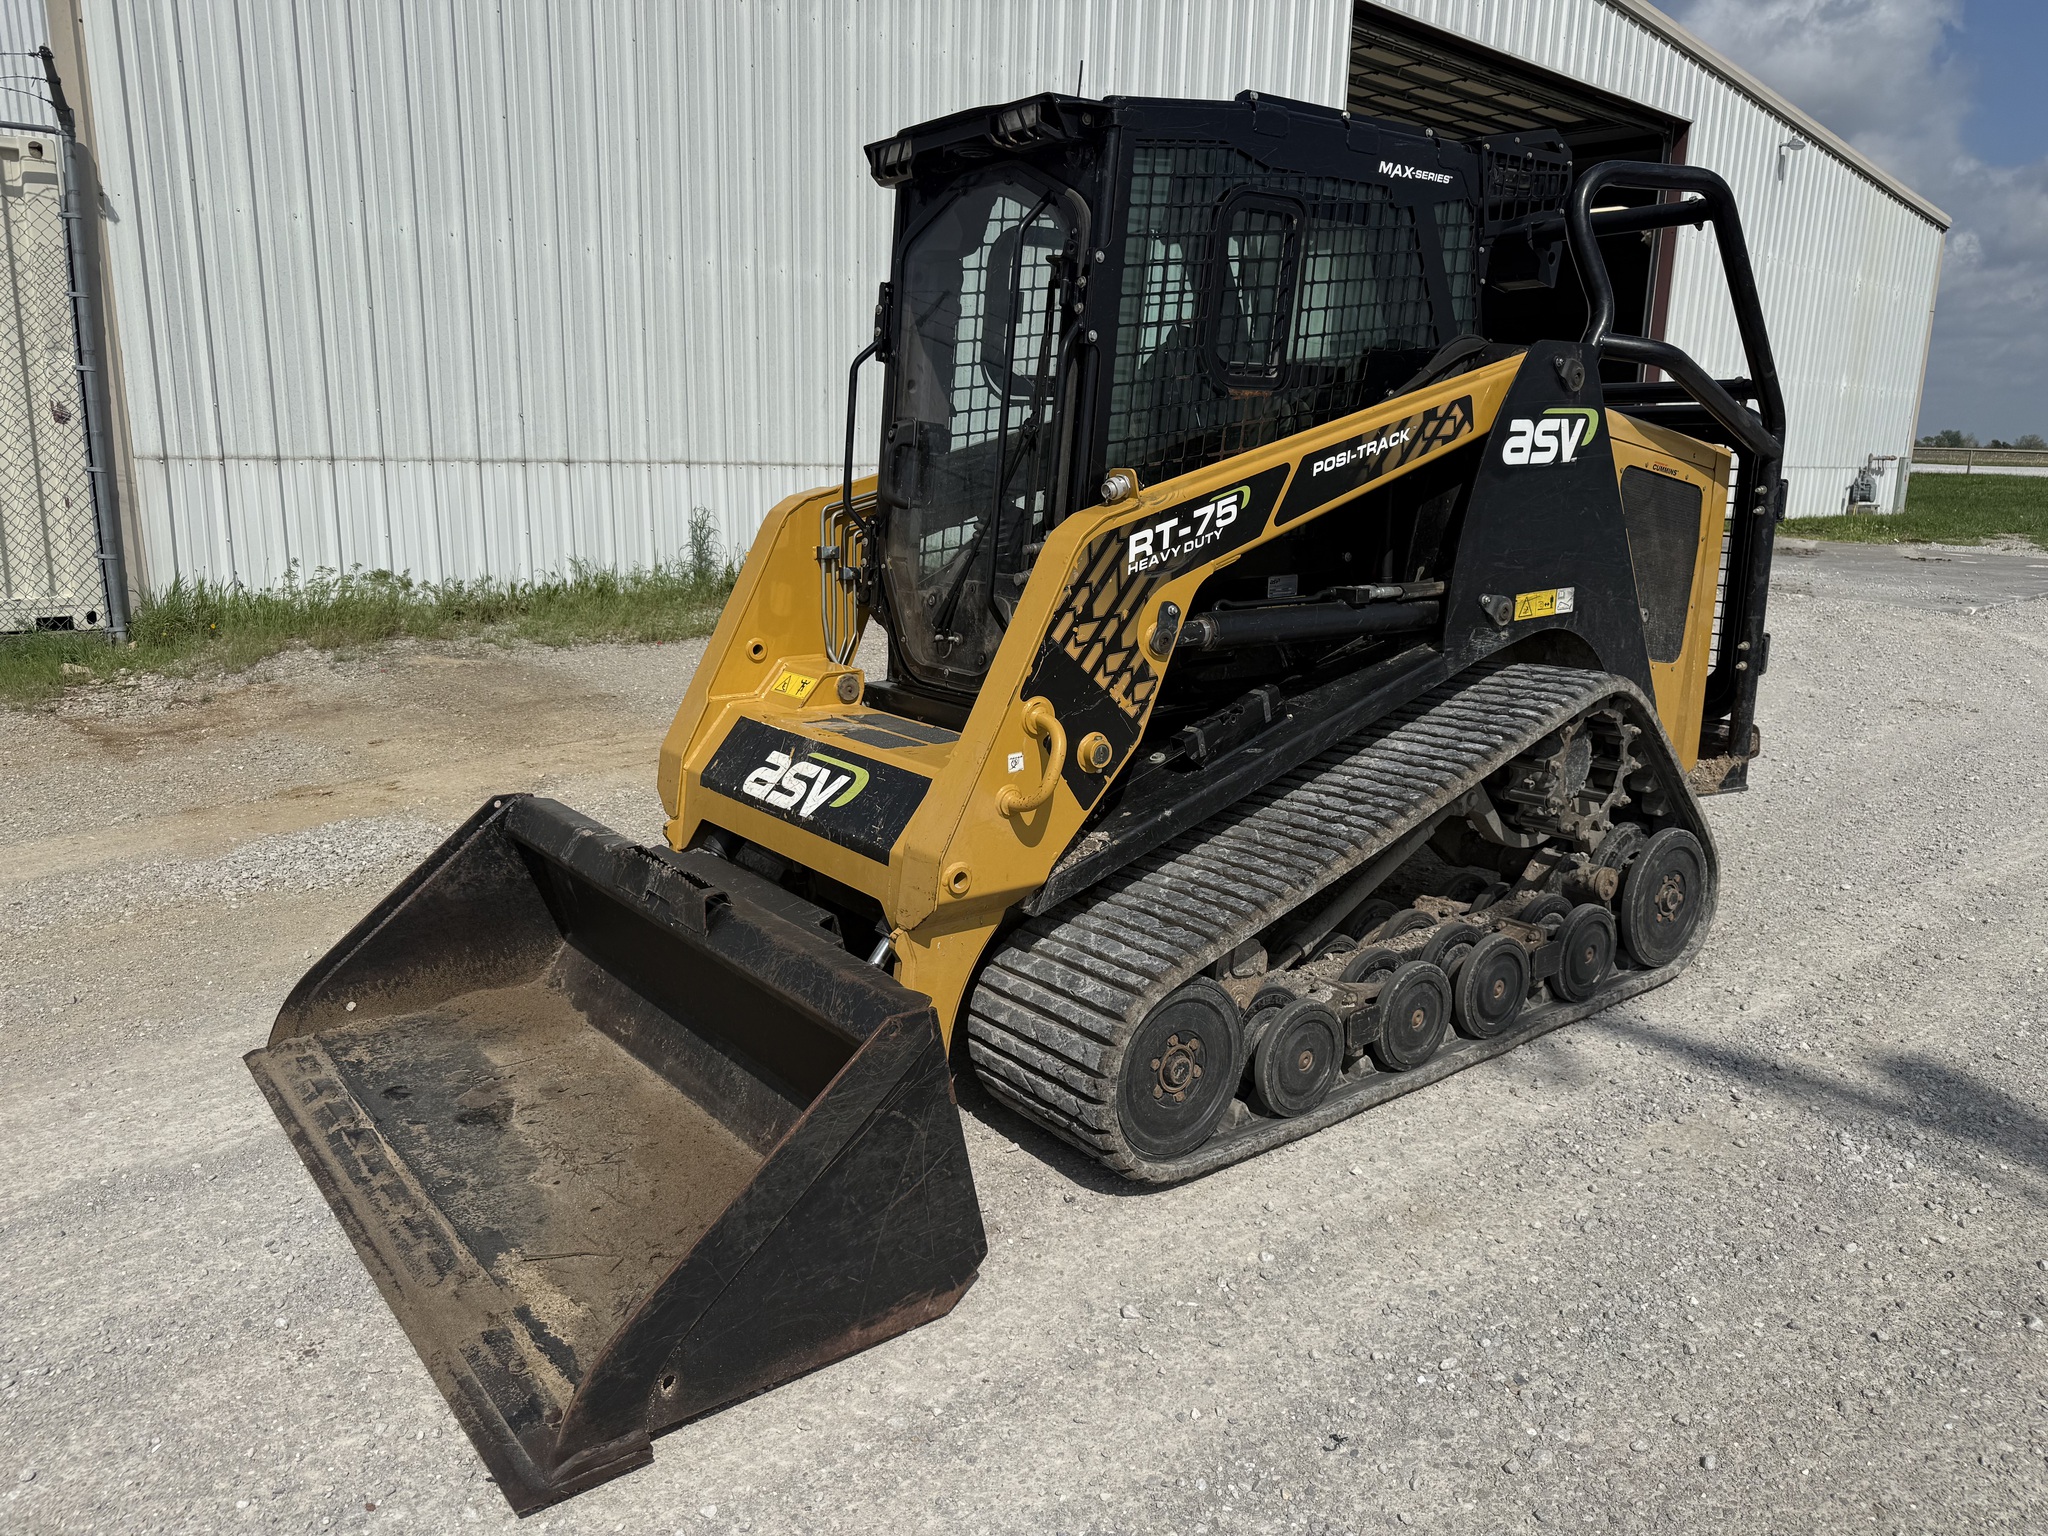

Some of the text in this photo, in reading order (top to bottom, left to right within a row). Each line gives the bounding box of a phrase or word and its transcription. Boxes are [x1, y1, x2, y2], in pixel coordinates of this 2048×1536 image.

[1312, 428, 1410, 477] POSI-TRACK
[1652, 463, 1677, 476] CUMMINS
[1127, 528, 1223, 575] HEAVY DUTY
[1128, 494, 1238, 563] RT-75
